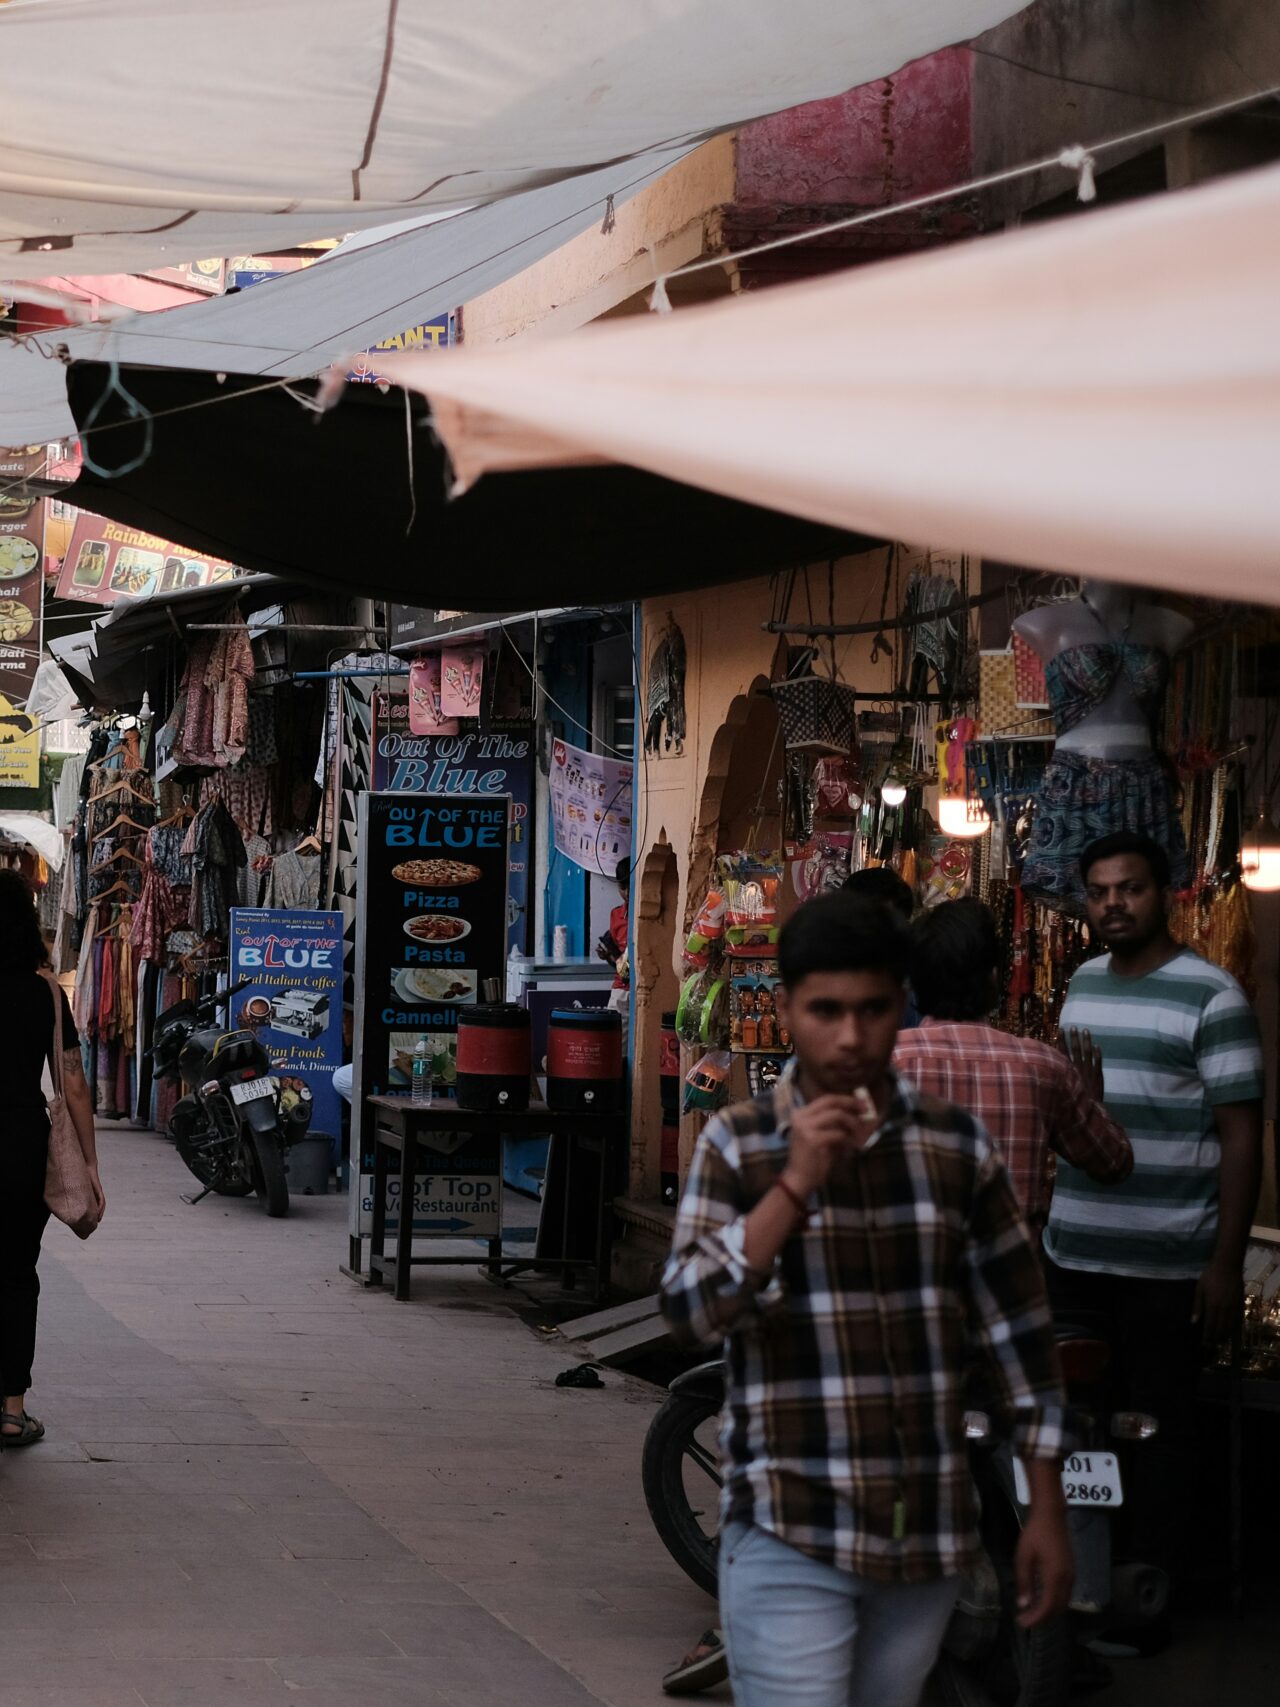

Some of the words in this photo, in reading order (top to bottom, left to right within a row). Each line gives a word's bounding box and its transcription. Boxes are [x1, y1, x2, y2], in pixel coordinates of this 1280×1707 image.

[102, 523, 169, 551] Rainbow
[378, 703, 410, 718] Bes
[378, 733, 430, 758] Out
[436, 734, 476, 764] Of
[477, 734, 529, 758] The
[390, 758, 507, 793] Blue
[437, 808, 463, 822] OF
[466, 810, 504, 823] THE
[385, 823, 503, 848] BLUE
[403, 892, 460, 909] Pizza
[279, 937, 303, 948] OF
[303, 938, 340, 949] THE
[238, 946, 333, 969] BLUE
[404, 946, 466, 963] Pasta
[238, 972, 263, 985] Ral
[265, 973, 301, 986] Italian
[304, 975, 337, 990] Coffee
[381, 1007, 460, 1025] Cannell
[290, 1045, 326, 1059] Foods
[443, 1177, 492, 1201] Top
[413, 1198, 498, 1213] Restaurant
[1065, 1483, 1112, 1502] 2869
